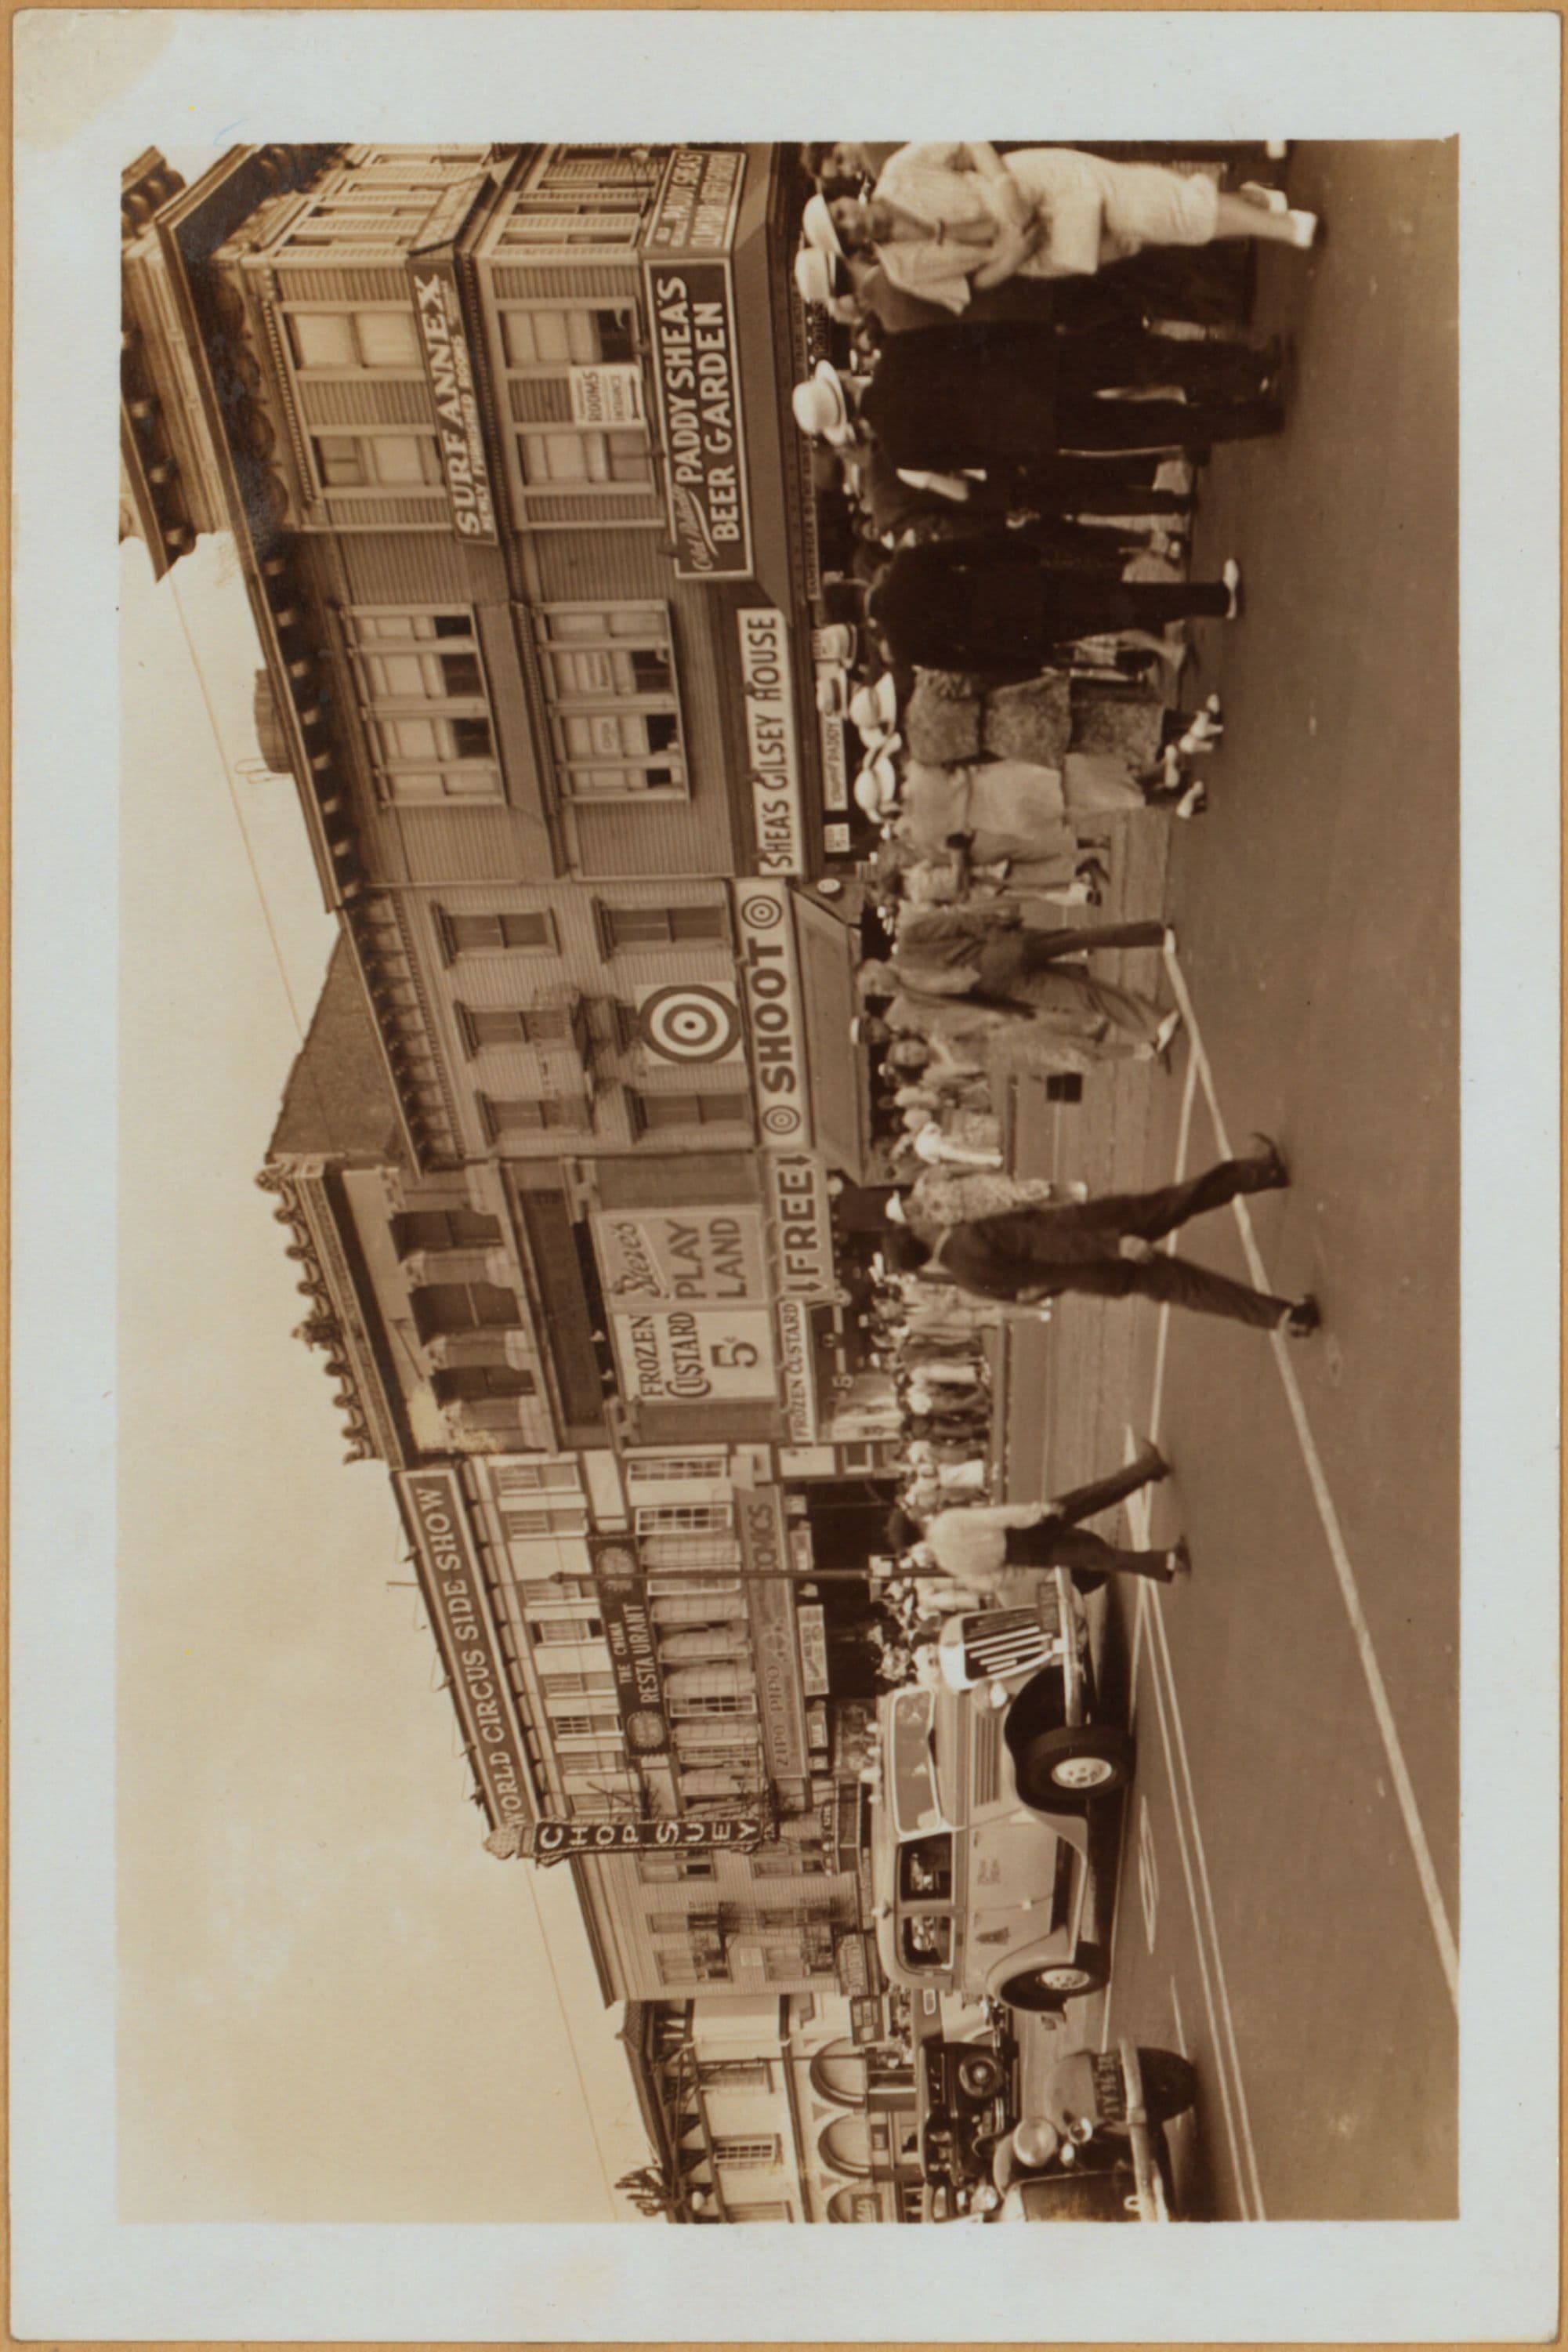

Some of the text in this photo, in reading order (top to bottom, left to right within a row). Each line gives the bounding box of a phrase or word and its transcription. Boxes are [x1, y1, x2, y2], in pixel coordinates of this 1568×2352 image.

[414, 273, 464, 426] ANNEX
[657, 275, 695, 388] SHEA'S
[582, 370, 602, 421] ROOMS
[668, 393, 704, 482] PADDY
[693, 300, 741, 540] BEER GARDEN
[442, 429, 481, 534] SURF
[746, 616, 794, 867] SHEA'S GILSEY HOUSE
[747, 937, 796, 1093] SHOOT
[666, 1218, 707, 1297] PLAY
[708, 1216, 747, 1297] LAND
[778, 1170, 820, 1274] FREE
[628, 1313, 664, 1396] FROZEN
[665, 1310, 712, 1397] CUSTARD
[782, 1303, 808, 1437] FROZEN CUSTARD
[415, 1486, 526, 1825] WORLD CIRCUS SIDE SHOW
[617, 1662, 632, 1683] THE
[538, 1824, 639, 1848] CHOP
[655, 1818, 759, 1843] SUEY
